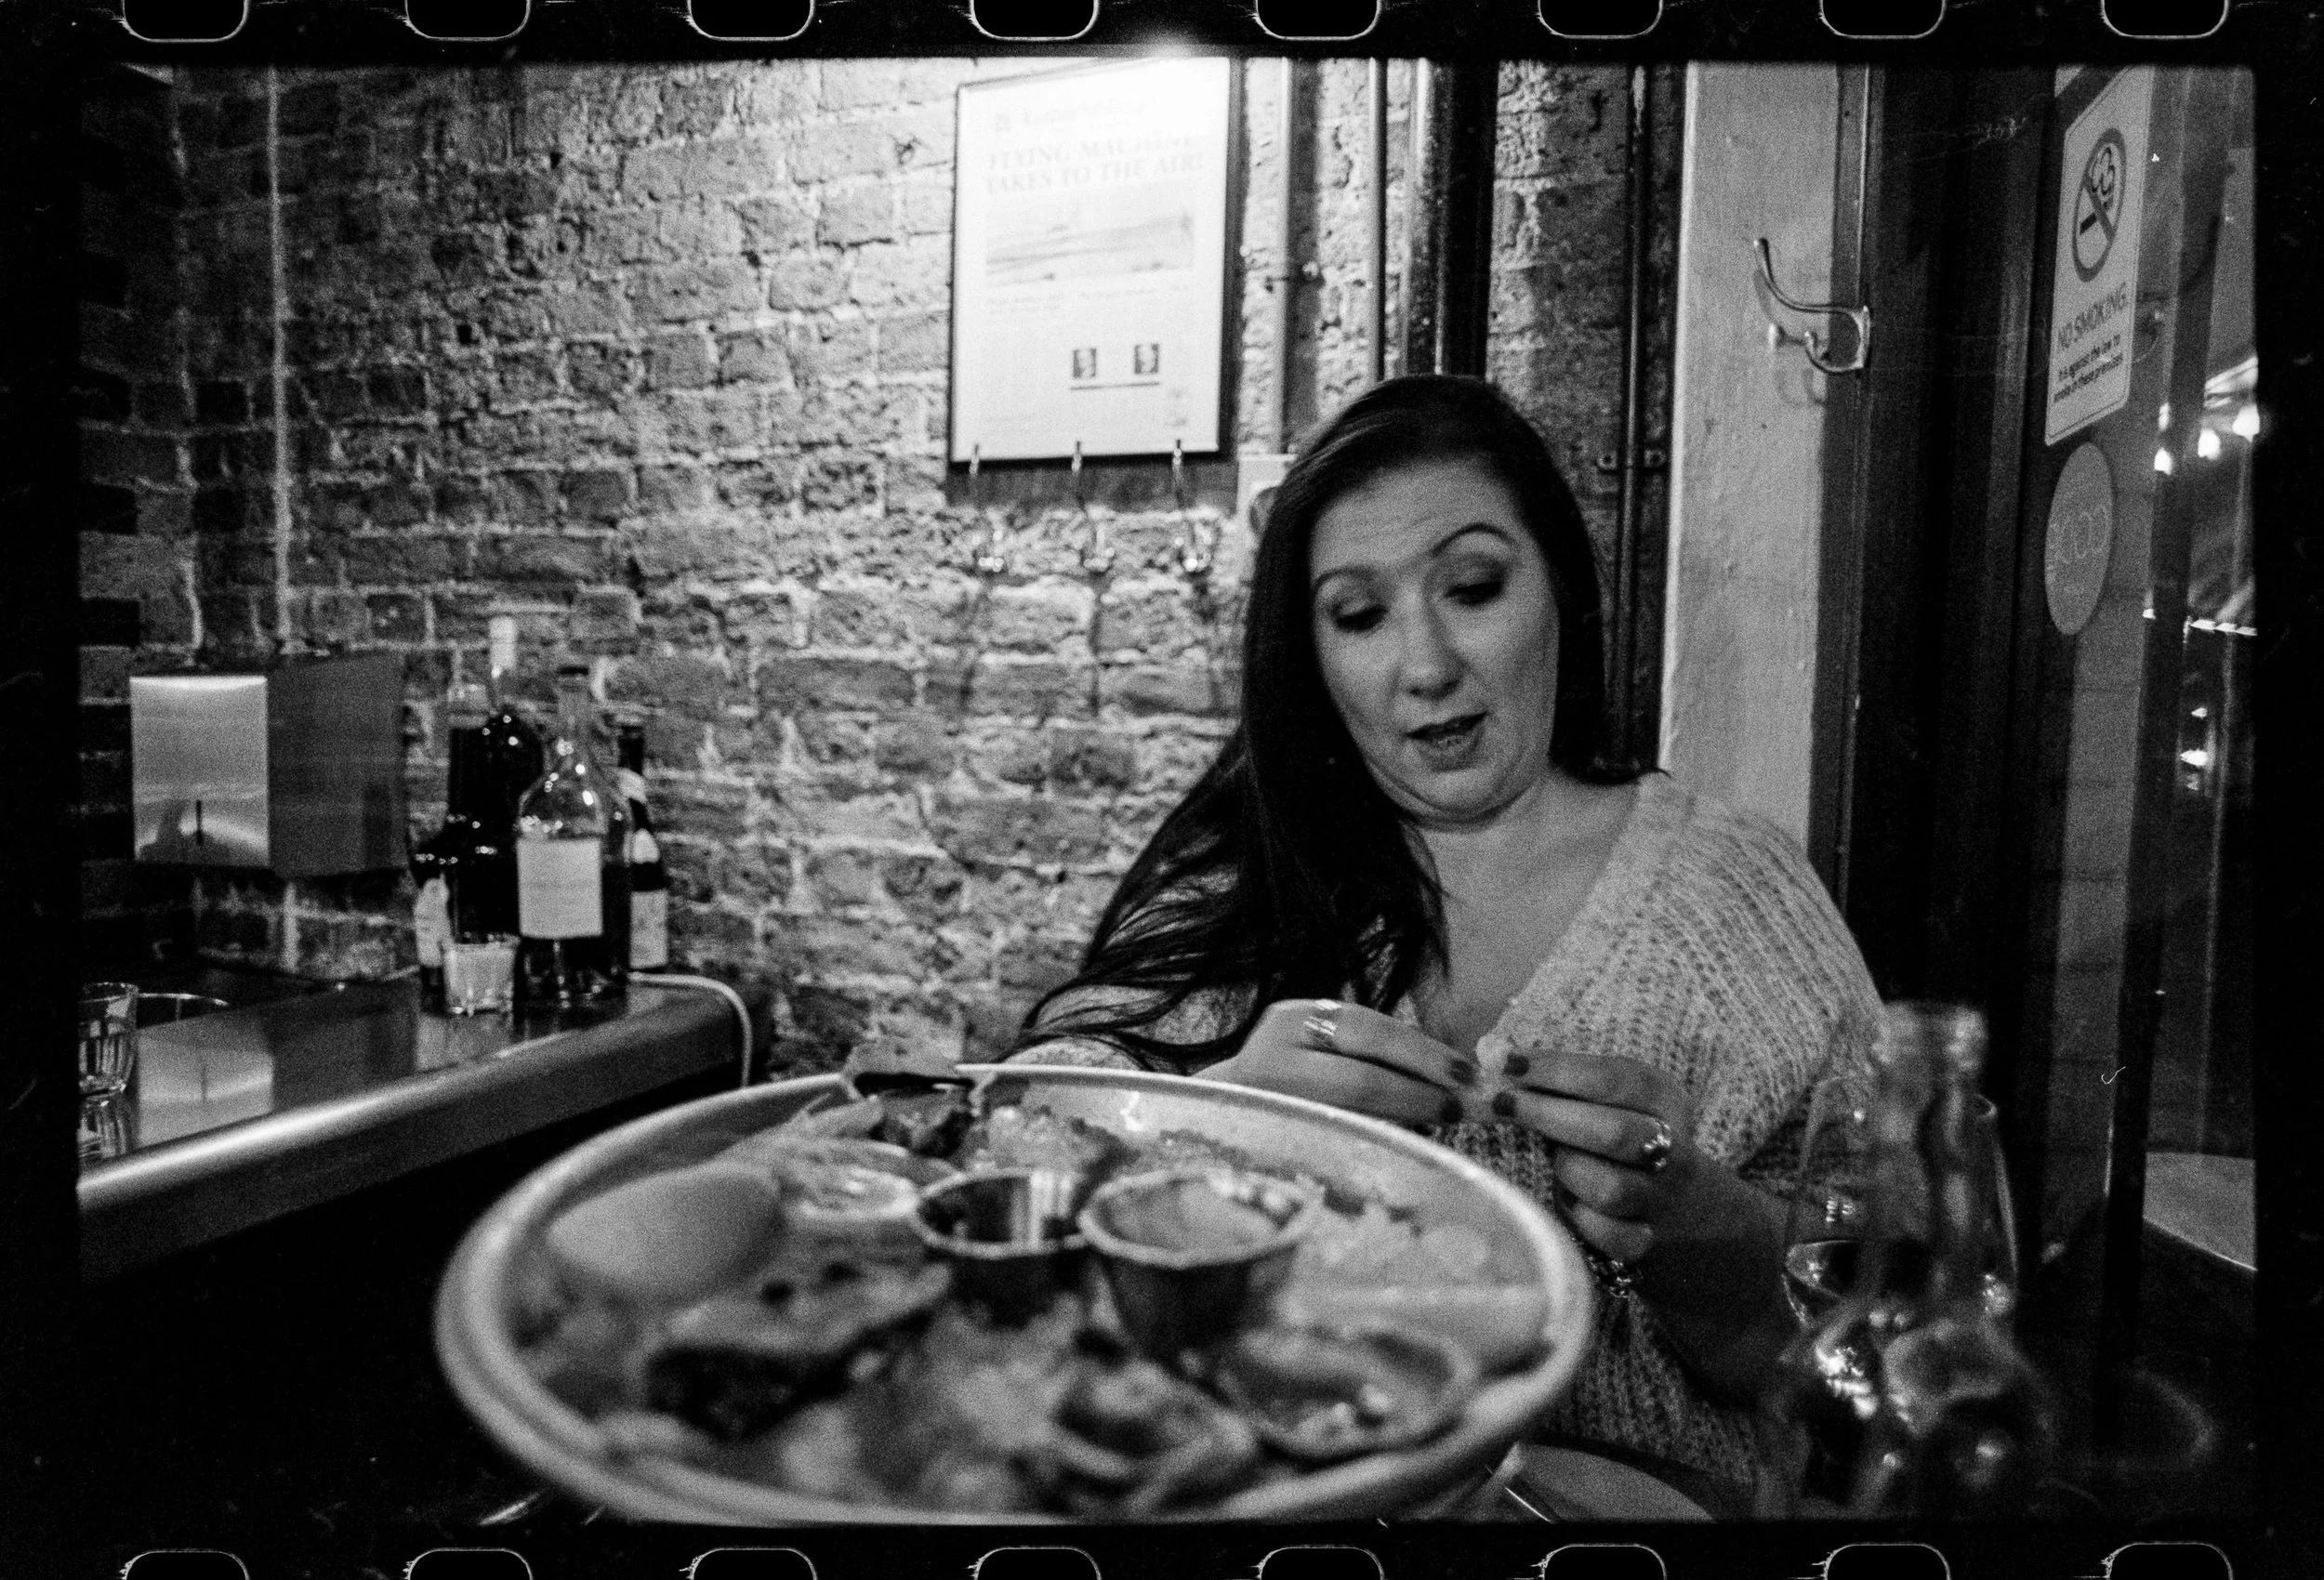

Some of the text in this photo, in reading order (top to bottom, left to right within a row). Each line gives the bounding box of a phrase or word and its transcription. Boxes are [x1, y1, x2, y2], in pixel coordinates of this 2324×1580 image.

[988, 142, 1071, 171] FLYING
[984, 171, 1052, 195] TAKES
[1062, 165, 1090, 186] TO
[1101, 158, 1149, 181] THE
[2058, 322, 2073, 349] NO
